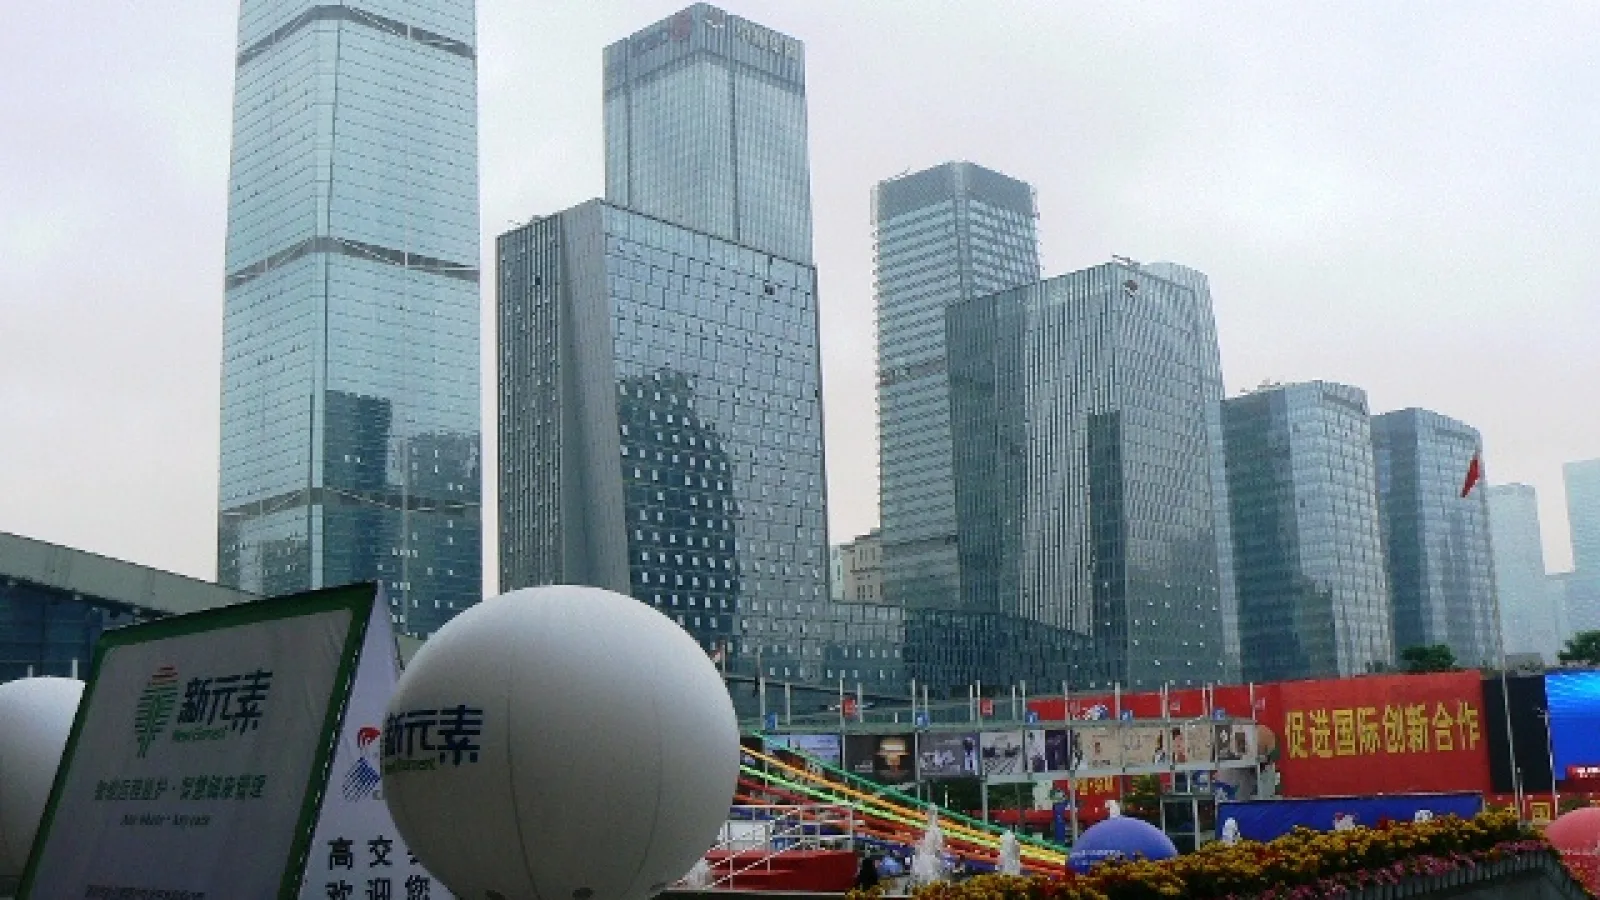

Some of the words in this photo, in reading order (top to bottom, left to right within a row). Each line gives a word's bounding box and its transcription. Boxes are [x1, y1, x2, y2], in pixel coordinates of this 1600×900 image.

[178, 667, 273, 735] 新元素
[1285, 701, 1480, 758] 促进国际创新合作
[325, 875, 431, 900] 欢迎您
